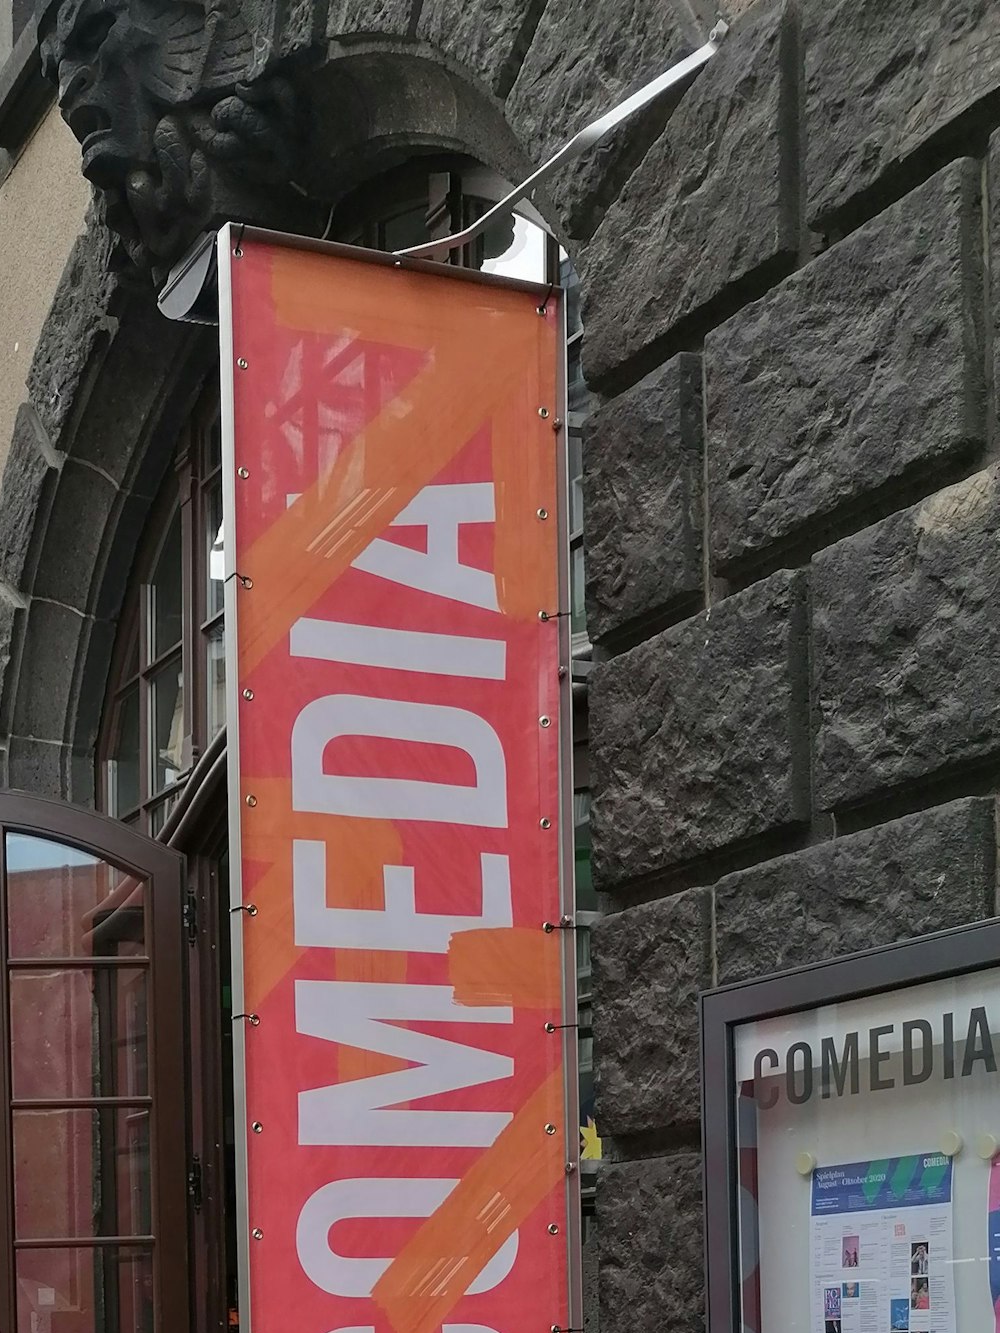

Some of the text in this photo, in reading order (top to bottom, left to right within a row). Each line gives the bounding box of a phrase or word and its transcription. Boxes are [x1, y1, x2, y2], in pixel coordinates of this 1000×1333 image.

[754, 1006, 998, 1111] COMEDIA
[923, 1156, 950, 1168] COMEDIA
[816, 1170, 846, 1181] Spielplan
[841, 1173, 868, 1186] Oktober
[868, 1173, 887, 1183] 2020
